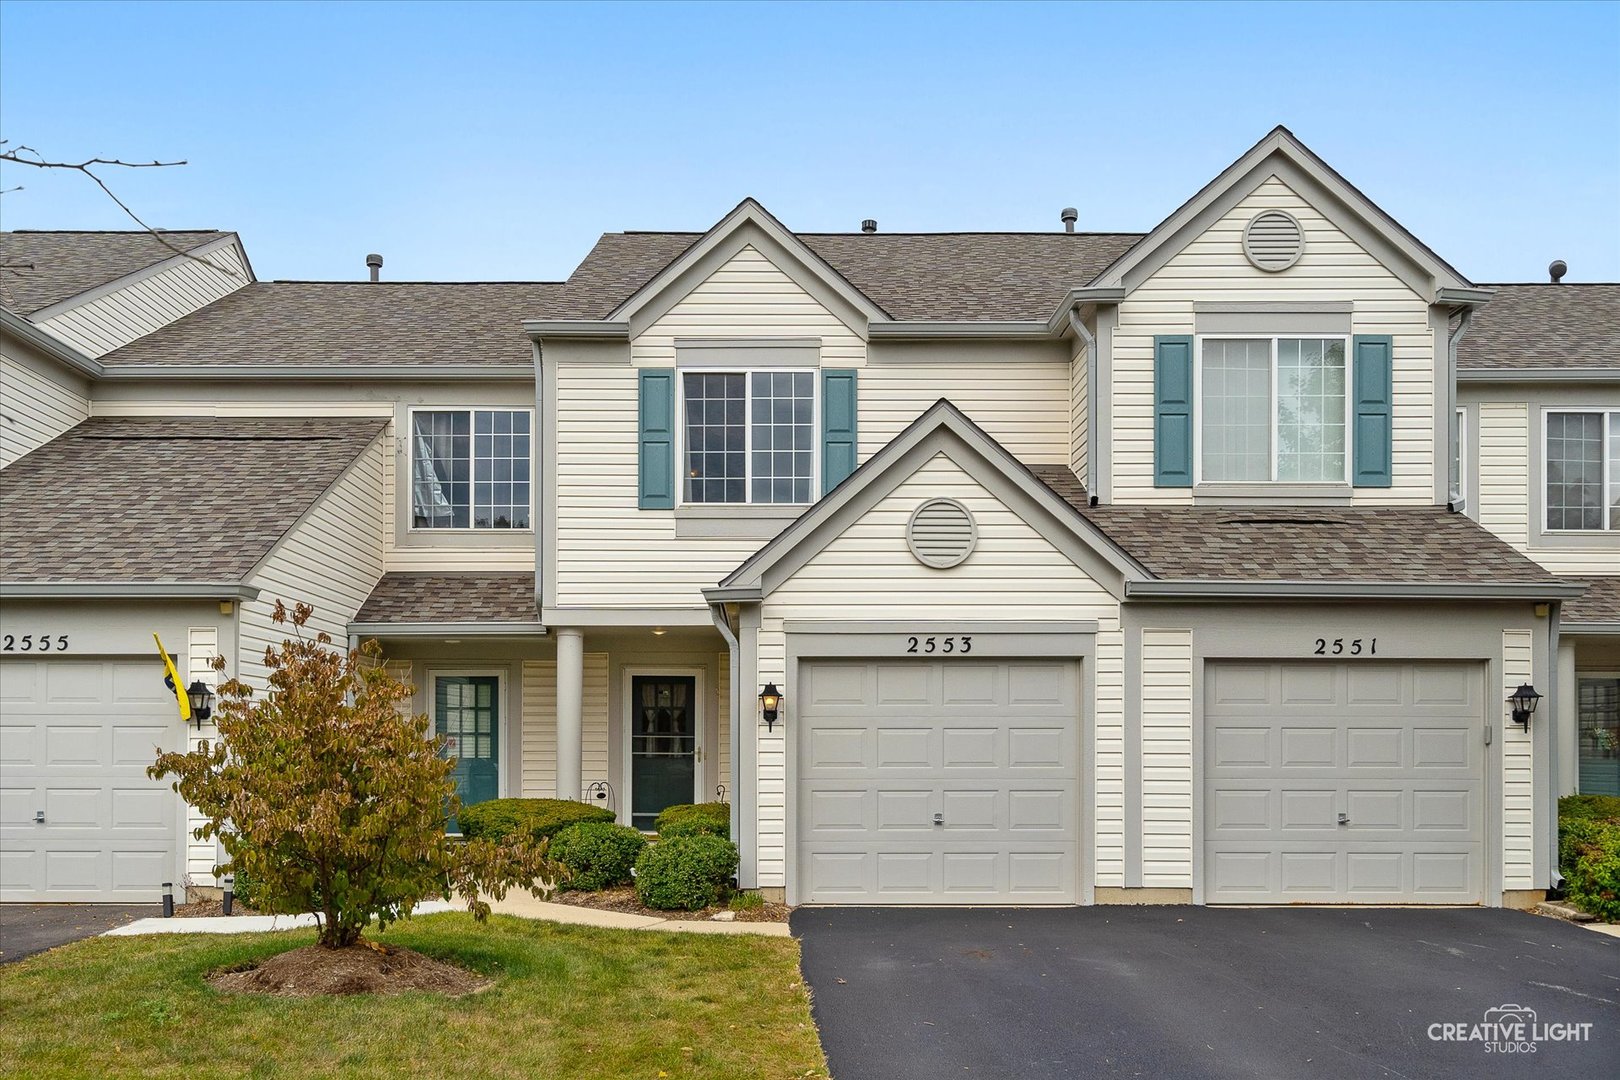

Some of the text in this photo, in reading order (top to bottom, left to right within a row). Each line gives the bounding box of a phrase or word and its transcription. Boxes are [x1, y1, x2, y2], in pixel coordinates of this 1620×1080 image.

[3, 634, 69, 651] 2555
[907, 636, 972, 653] 2553
[1314, 638, 1377, 655] 2551
